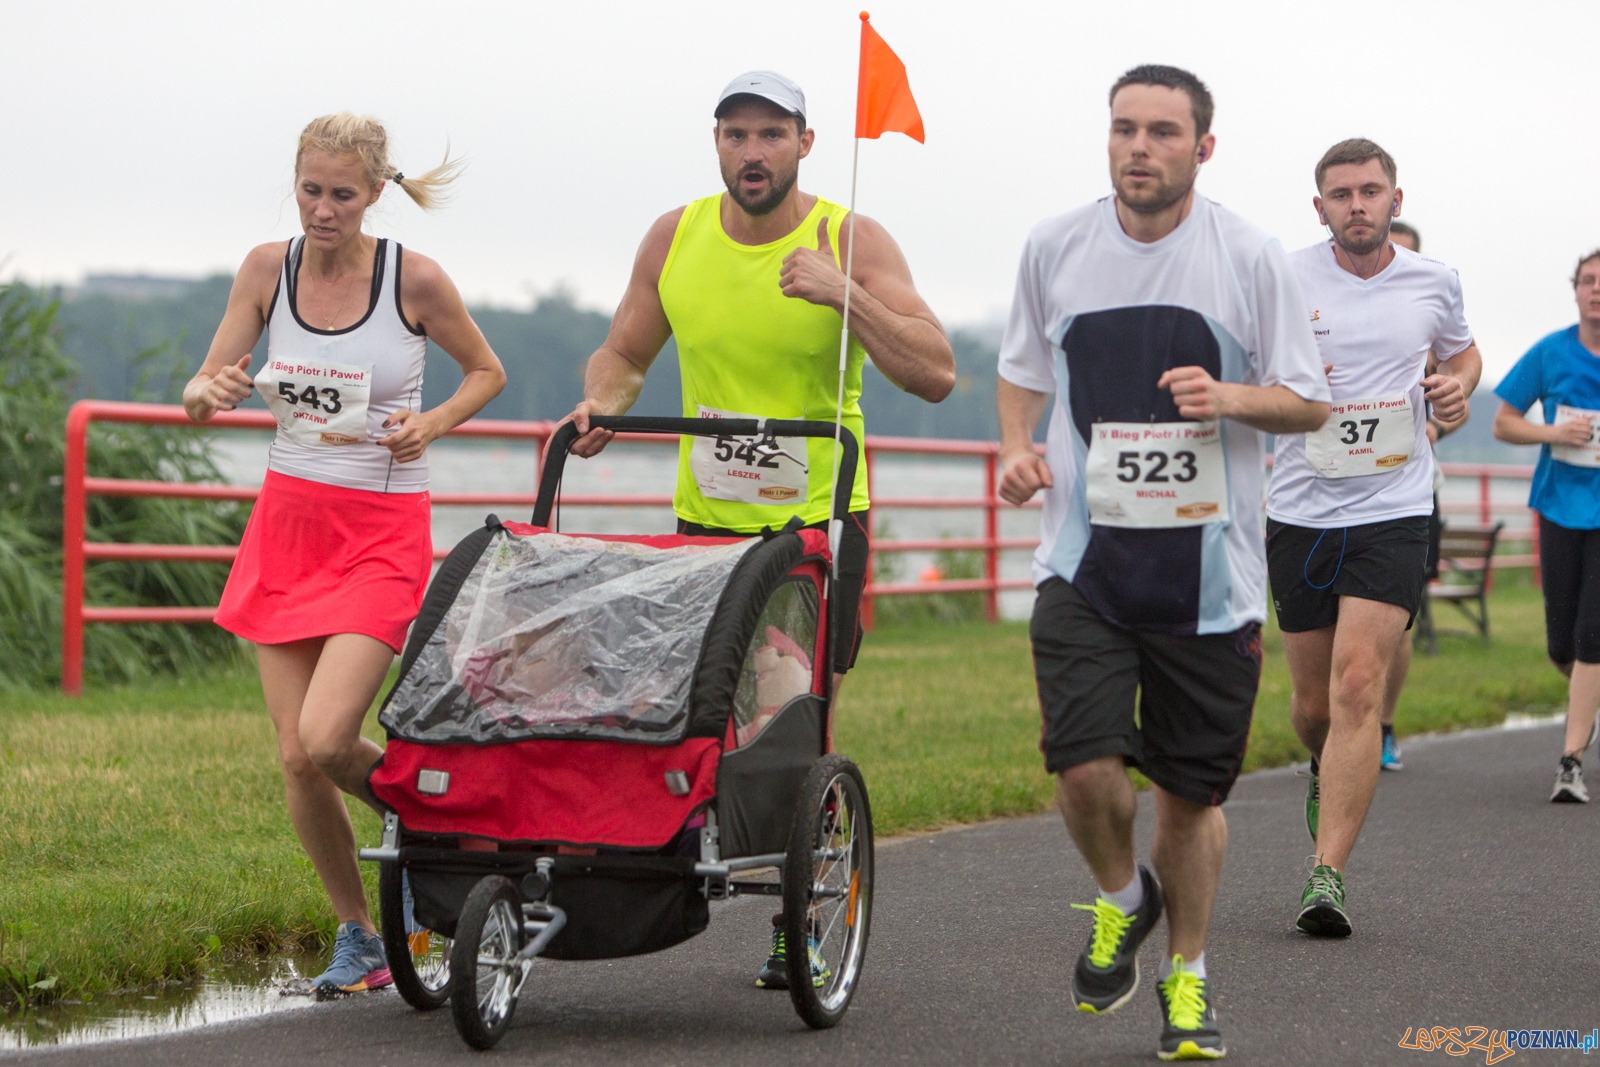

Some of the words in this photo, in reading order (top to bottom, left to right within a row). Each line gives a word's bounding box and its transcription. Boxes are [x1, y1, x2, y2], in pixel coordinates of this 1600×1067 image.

[275, 361, 294, 374] Bieg
[296, 365, 320, 377] Piotr
[324, 368, 327, 377] i
[330, 369, 364, 381] Paweł
[278, 381, 342, 414] 543
[1329, 405, 1345, 414] ieg
[1347, 403, 1370, 412] Piotr
[293, 411, 328, 425] OKTAWIA
[1111, 430, 1139, 441] Bieg
[1143, 429, 1172, 439] Piotr
[1176, 429, 1180, 438] i
[1340, 418, 1380, 445] 37
[714, 435, 779, 469] 542
[1348, 447, 1374, 456] KAMIL
[1116, 451, 1198, 482] 523
[727, 469, 761, 480] LESZEK
[1136, 489, 1178, 498] MICHAŁ
